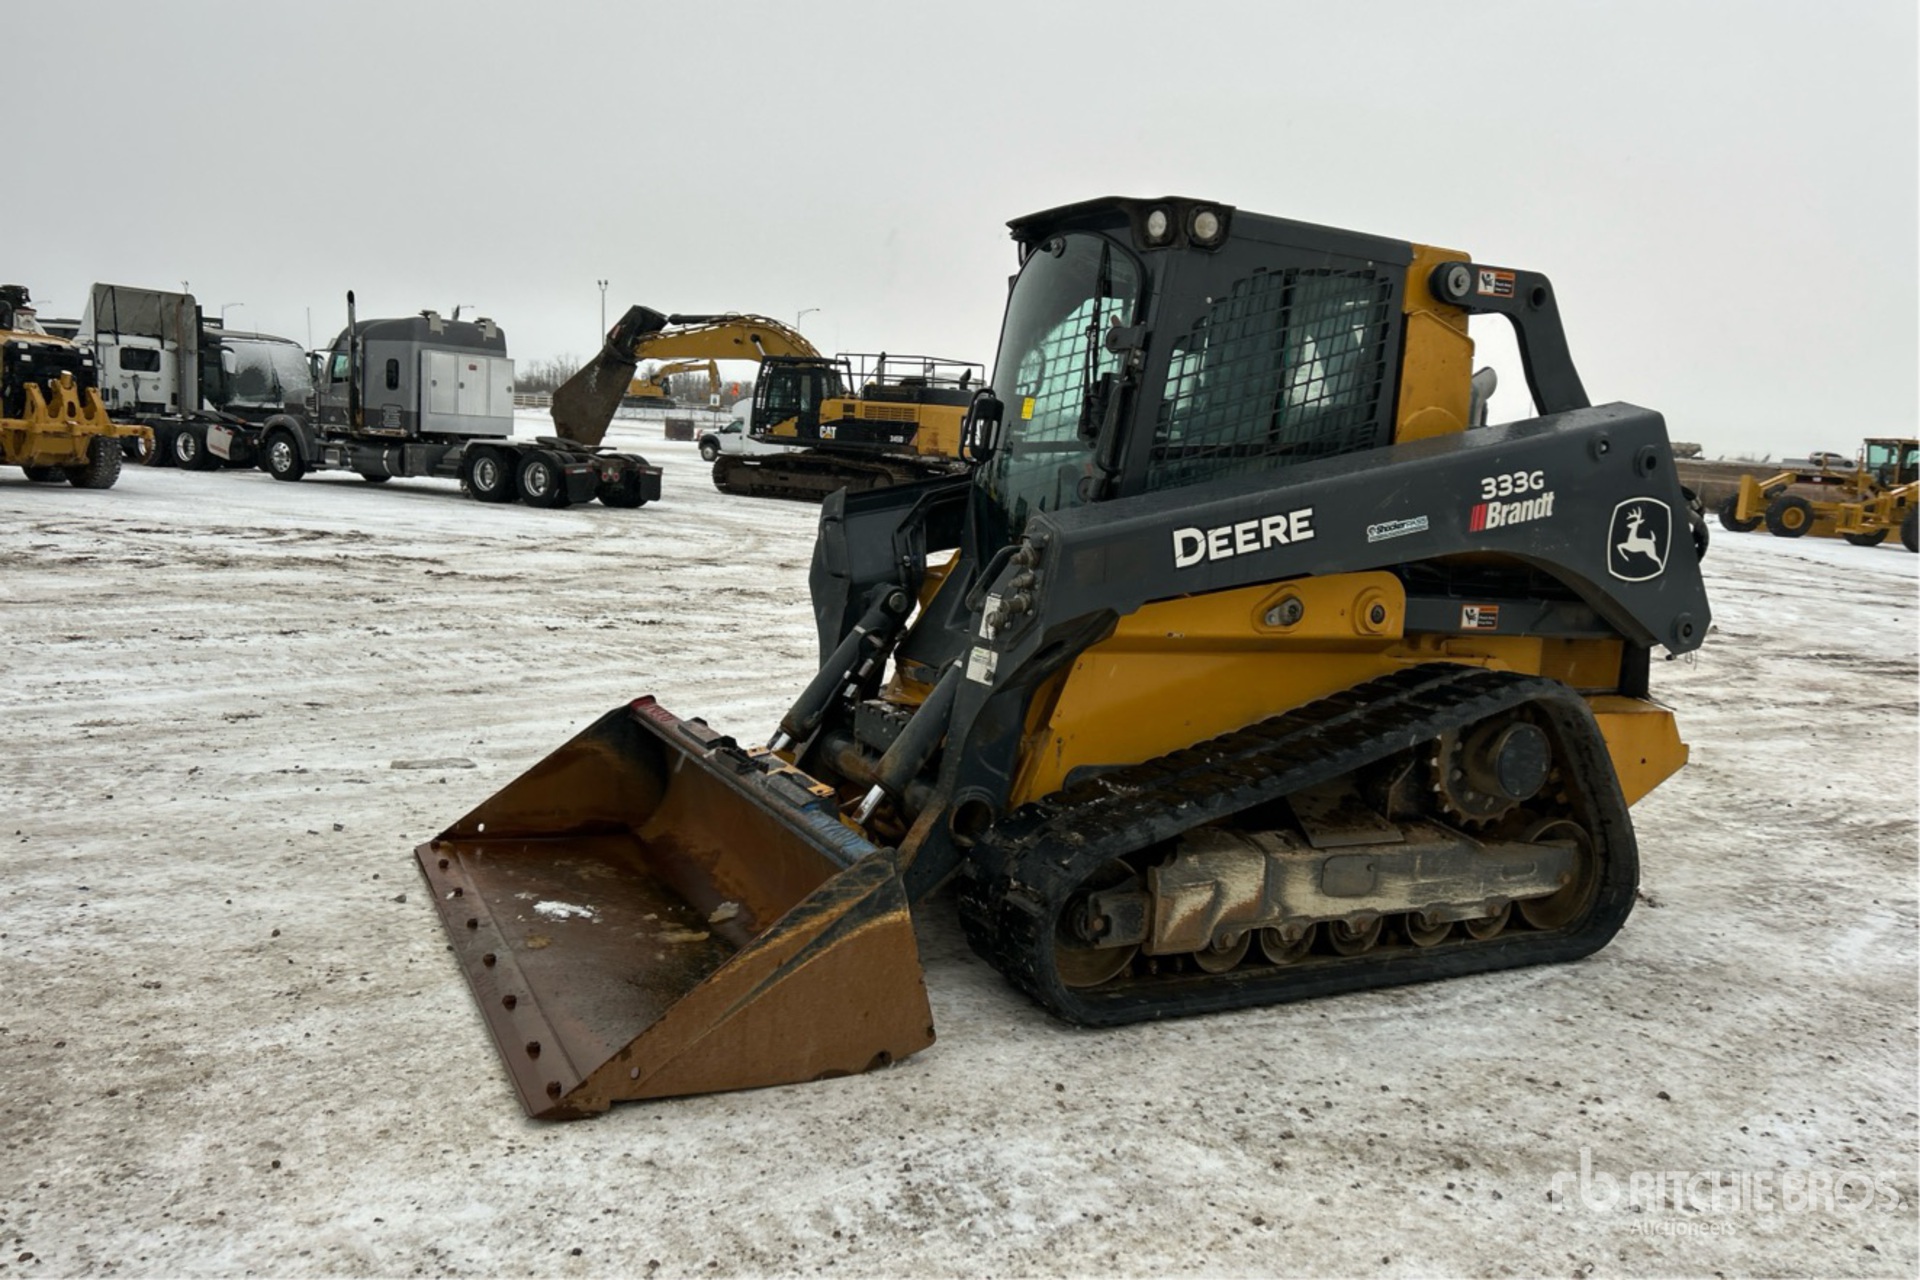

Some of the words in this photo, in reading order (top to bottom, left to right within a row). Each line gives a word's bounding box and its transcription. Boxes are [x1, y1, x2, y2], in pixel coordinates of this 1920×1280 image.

[819, 426, 837, 439] CAT
[1481, 470, 1544, 500] 333G
[1486, 491, 1555, 530] Brandt
[1173, 507, 1315, 568] DEERE
